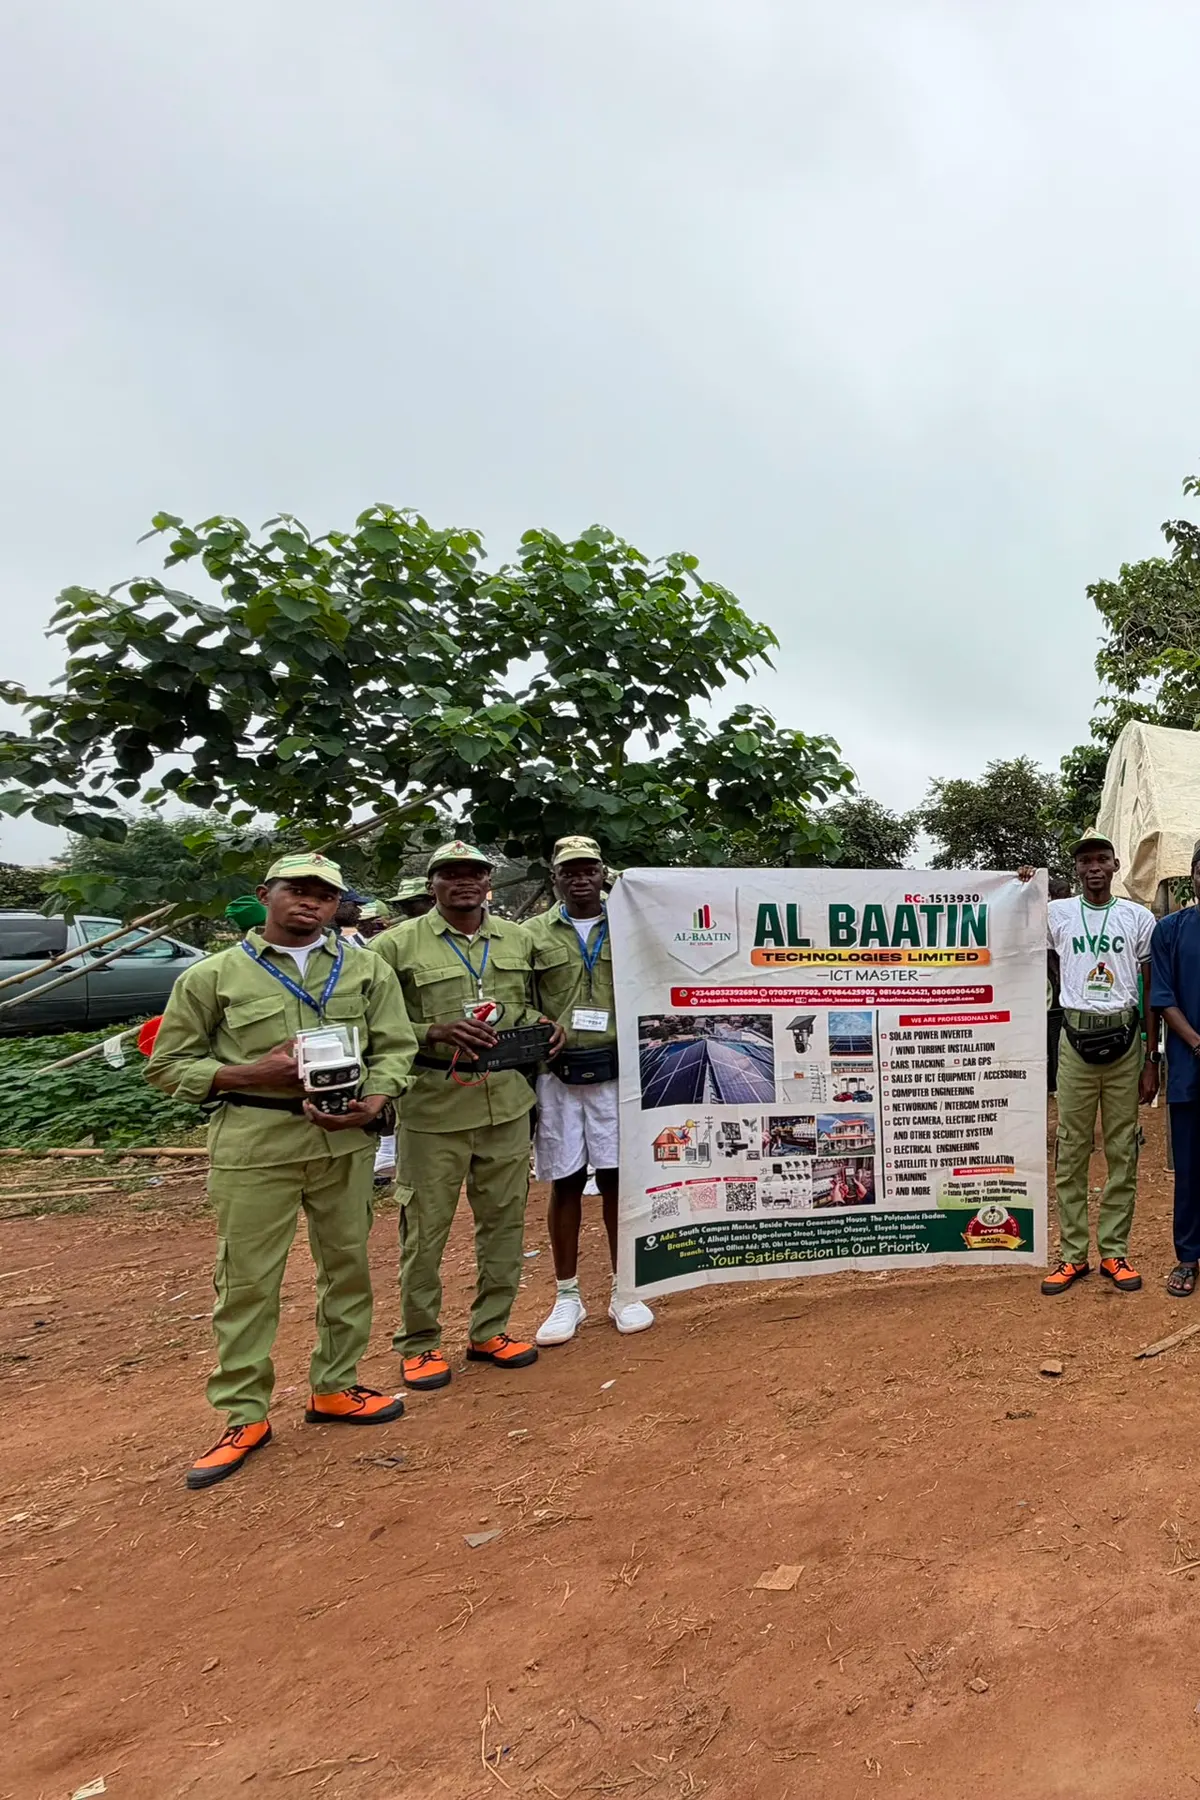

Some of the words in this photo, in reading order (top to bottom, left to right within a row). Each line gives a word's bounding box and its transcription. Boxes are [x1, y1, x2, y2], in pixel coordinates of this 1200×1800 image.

[904, 894, 926, 903] RC:
[928, 894, 980, 903] 1513930
[754, 903, 812, 947] AL
[828, 903, 988, 947] BAATIN
[673, 932, 732, 942] AL-BAATIN
[1072, 935, 1125, 954] NYSC
[762, 952, 902, 962] TECHNOLOGIES
[908, 952, 979, 962] LIMITED
[830, 970, 852, 981] ICT
[856, 970, 919, 981] MASTER
[889, 1031, 912, 1041] SOLAR
[914, 1030, 939, 1040] POWER
[940, 1029, 973, 1039] INVERTER
[896, 1045, 915, 1055] WIND
[917, 1044, 946, 1054] TURBINE
[948, 1043, 996, 1054] INSTALLATION
[890, 1060, 910, 1069] CARS
[912, 1059, 945, 1069] TRACKING
[962, 1057, 977, 1066] CAR
[978, 1057, 992, 1066] GPS
[891, 1074, 913, 1083] SALES
[914, 1073, 924, 1083] OF
[924, 1073, 936, 1082] ICT
[937, 1072, 976, 1083] EQUIPMENT
[983, 1070, 1027, 1080] ACCESSORIES
[891, 1088, 929, 1098] COMPUTER
[930, 1086, 975, 1097] ENGINEERING
[892, 1101, 938, 1112] NETWORKING
[944, 1100, 979, 1110] INTERCOM
[981, 1098, 1009, 1108] SYSTEM
[892, 1116, 911, 1126] CCTV
[912, 1115, 944, 1126] CAMERA,
[945, 1113, 976, 1124] ELECTRIC
[977, 1112, 998, 1123] FENCE
[893, 1131, 908, 1140] AND
[909, 1129, 931, 1140] OTHER
[932, 1128, 964, 1139] SECURITY
[965, 1127, 993, 1138] SYSTEM
[893, 1144, 932, 1154] ELECTRICAL
[936, 1142, 980, 1153] ENGINEERING
[894, 1158, 927, 1169] SATELLITE
[929, 1158, 938, 1168] TV
[939, 1156, 968, 1167] SYSTEM
[968, 1155, 1015, 1165] INSTALLATION
[895, 1172, 927, 1182] TRAINING
[895, 1186, 910, 1196] AND
[911, 1186, 931, 1195] MORE
[1001, 1187, 1028, 1196] Networking
[660, 1231, 677, 1242] Add:
[679, 1227, 700, 1237] South
[701, 1225, 730, 1234] Campus
[731, 1223, 758, 1231] Market,
[806, 1218, 844, 1226] Generating
[884, 1213, 921, 1221] Polytechnic
[921, 1212, 948, 1220] Ibadan.
[667, 1239, 696, 1251] Branch:
[707, 1234, 729, 1243] Alhaji
[730, 1233, 750, 1242] Lasisi
[751, 1231, 792, 1241] Ogo-oluwa
[793, 1229, 816, 1237] Street,
[900, 1222, 927, 1230] Ibadan.
[679, 1248, 704, 1258] Branch:
[706, 1246, 725, 1254] Lagos
[745, 1246, 834, 1264] Satisfaction
[837, 1245, 849, 1256] Is
[852, 1243, 876, 1255] Our
[879, 1240, 930, 1254] Priority
